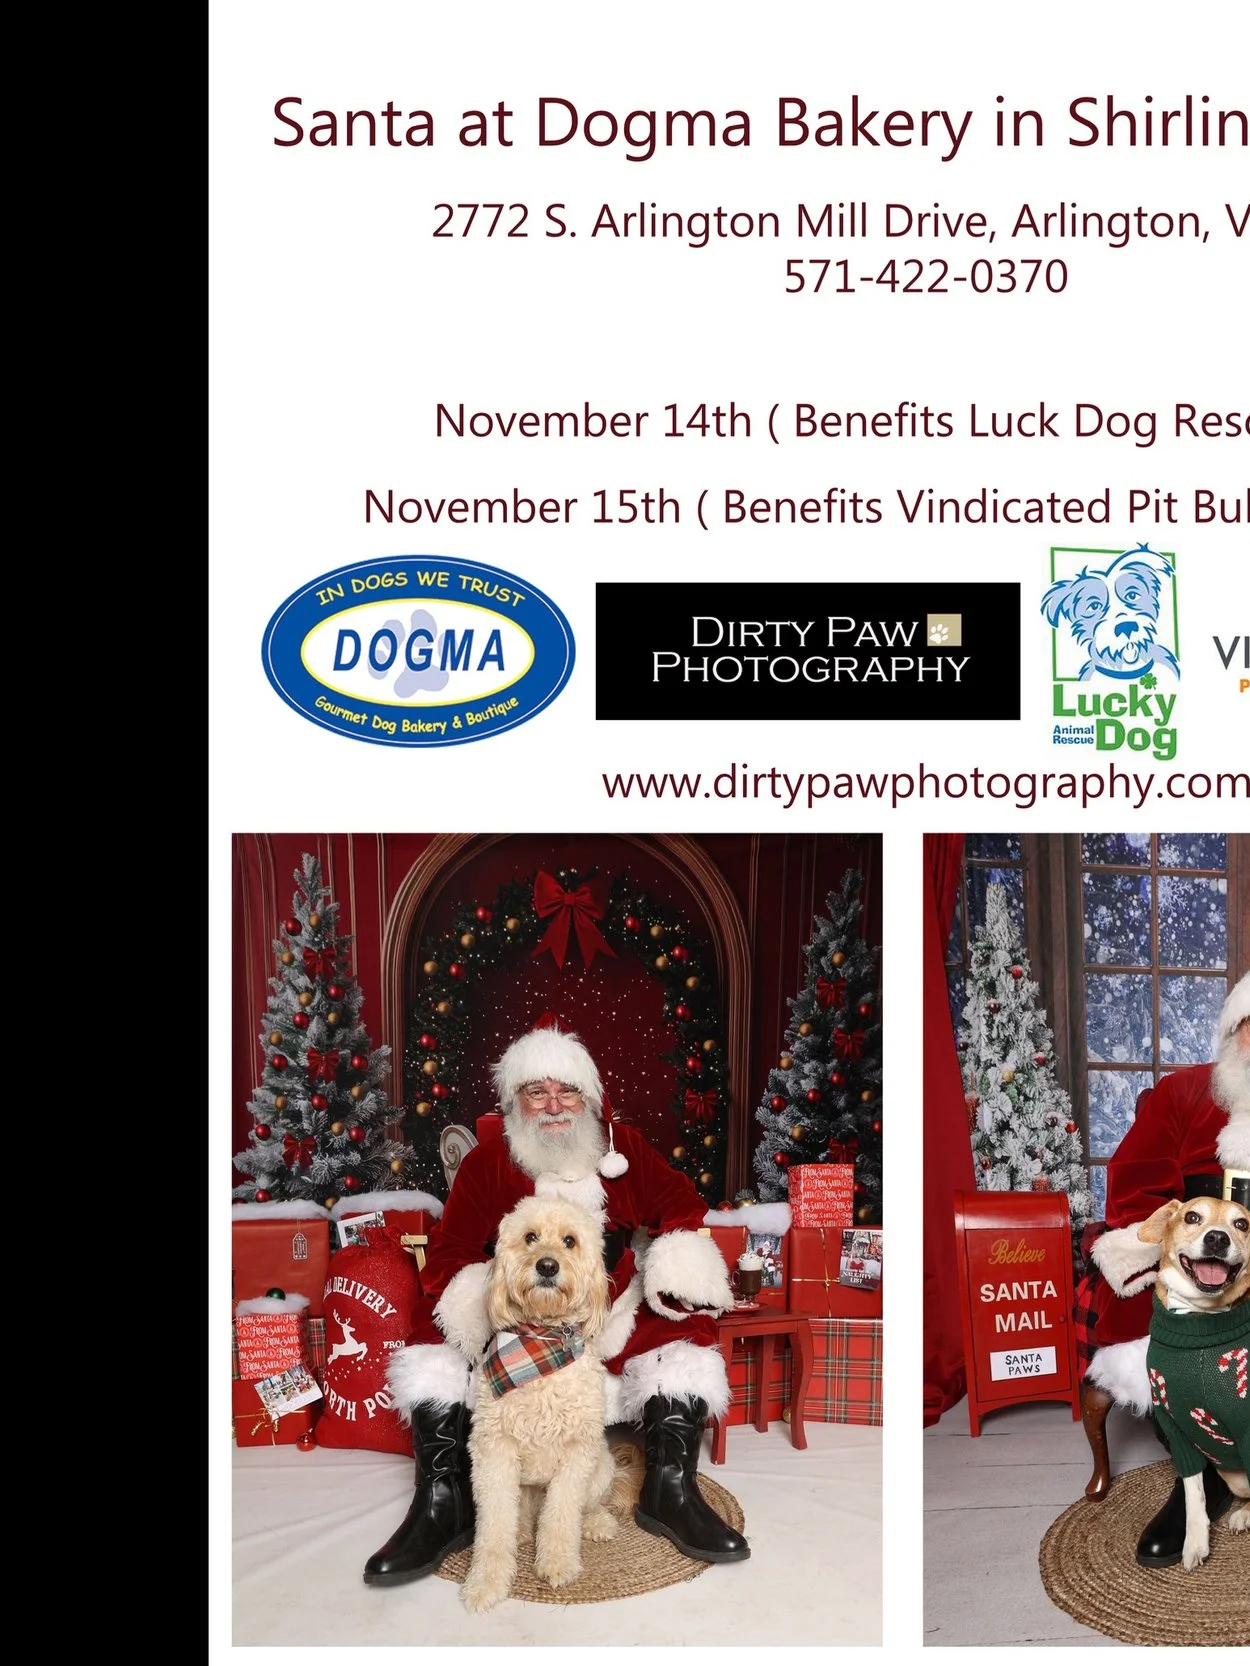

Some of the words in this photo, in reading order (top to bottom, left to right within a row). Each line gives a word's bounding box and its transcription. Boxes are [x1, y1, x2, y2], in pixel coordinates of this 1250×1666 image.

[988, 1238, 1046, 1265] Believe
[333, 1276, 397, 1319] DELIVERY
[980, 1280, 1058, 1302] SANTA
[995, 1310, 1052, 1333] MAIL
[1005, 1353, 1042, 1365] SANTA
[1008, 1364, 1040, 1376] PAWS
[323, 1381, 357, 1421] ORTH
